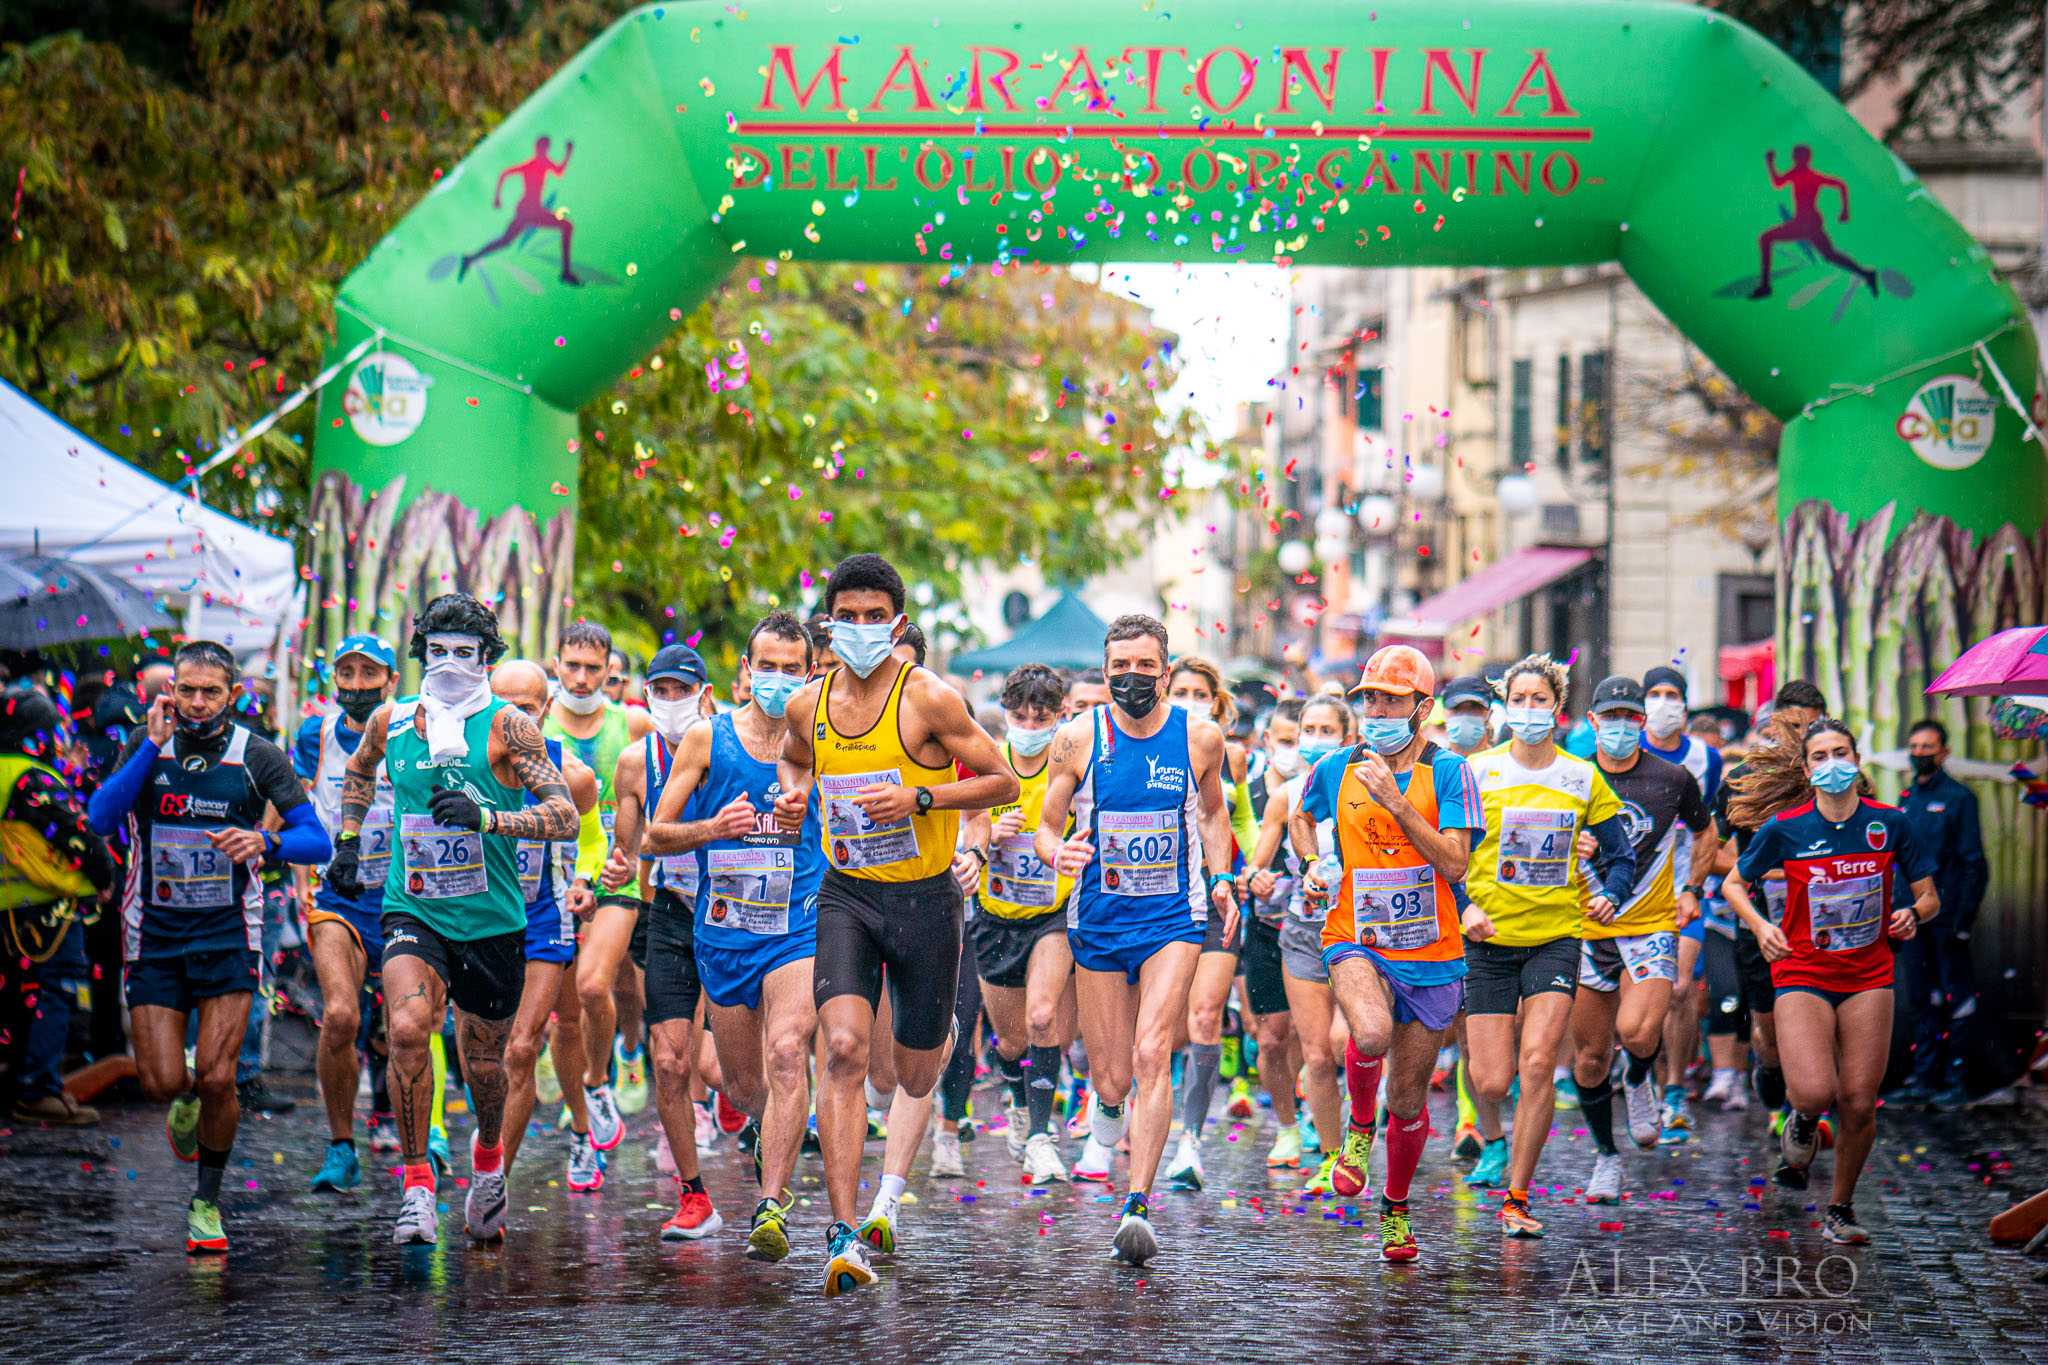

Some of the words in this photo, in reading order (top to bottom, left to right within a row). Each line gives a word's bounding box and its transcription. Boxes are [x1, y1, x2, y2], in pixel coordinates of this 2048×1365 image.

[752, 44, 1582, 119] MARATONINA
[728, 143, 1065, 193] DELL'OLIO
[1155, 766, 1184, 776] ATLETICA
[1159, 774, 1183, 784] COSTA
[435, 838, 469, 865] 26
[1127, 835, 1173, 863] 602
[1540, 833, 1555, 857] 4
[189, 851, 216, 875] 13
[775, 851, 786, 867] B
[1016, 855, 1044, 878] 32
[1832, 860, 1877, 875] Terre
[756, 875, 768, 900] 1
[1357, 871, 1408, 880] MARATONINA
[1391, 890, 1421, 919] 93
[1851, 899, 1865, 922] 7
